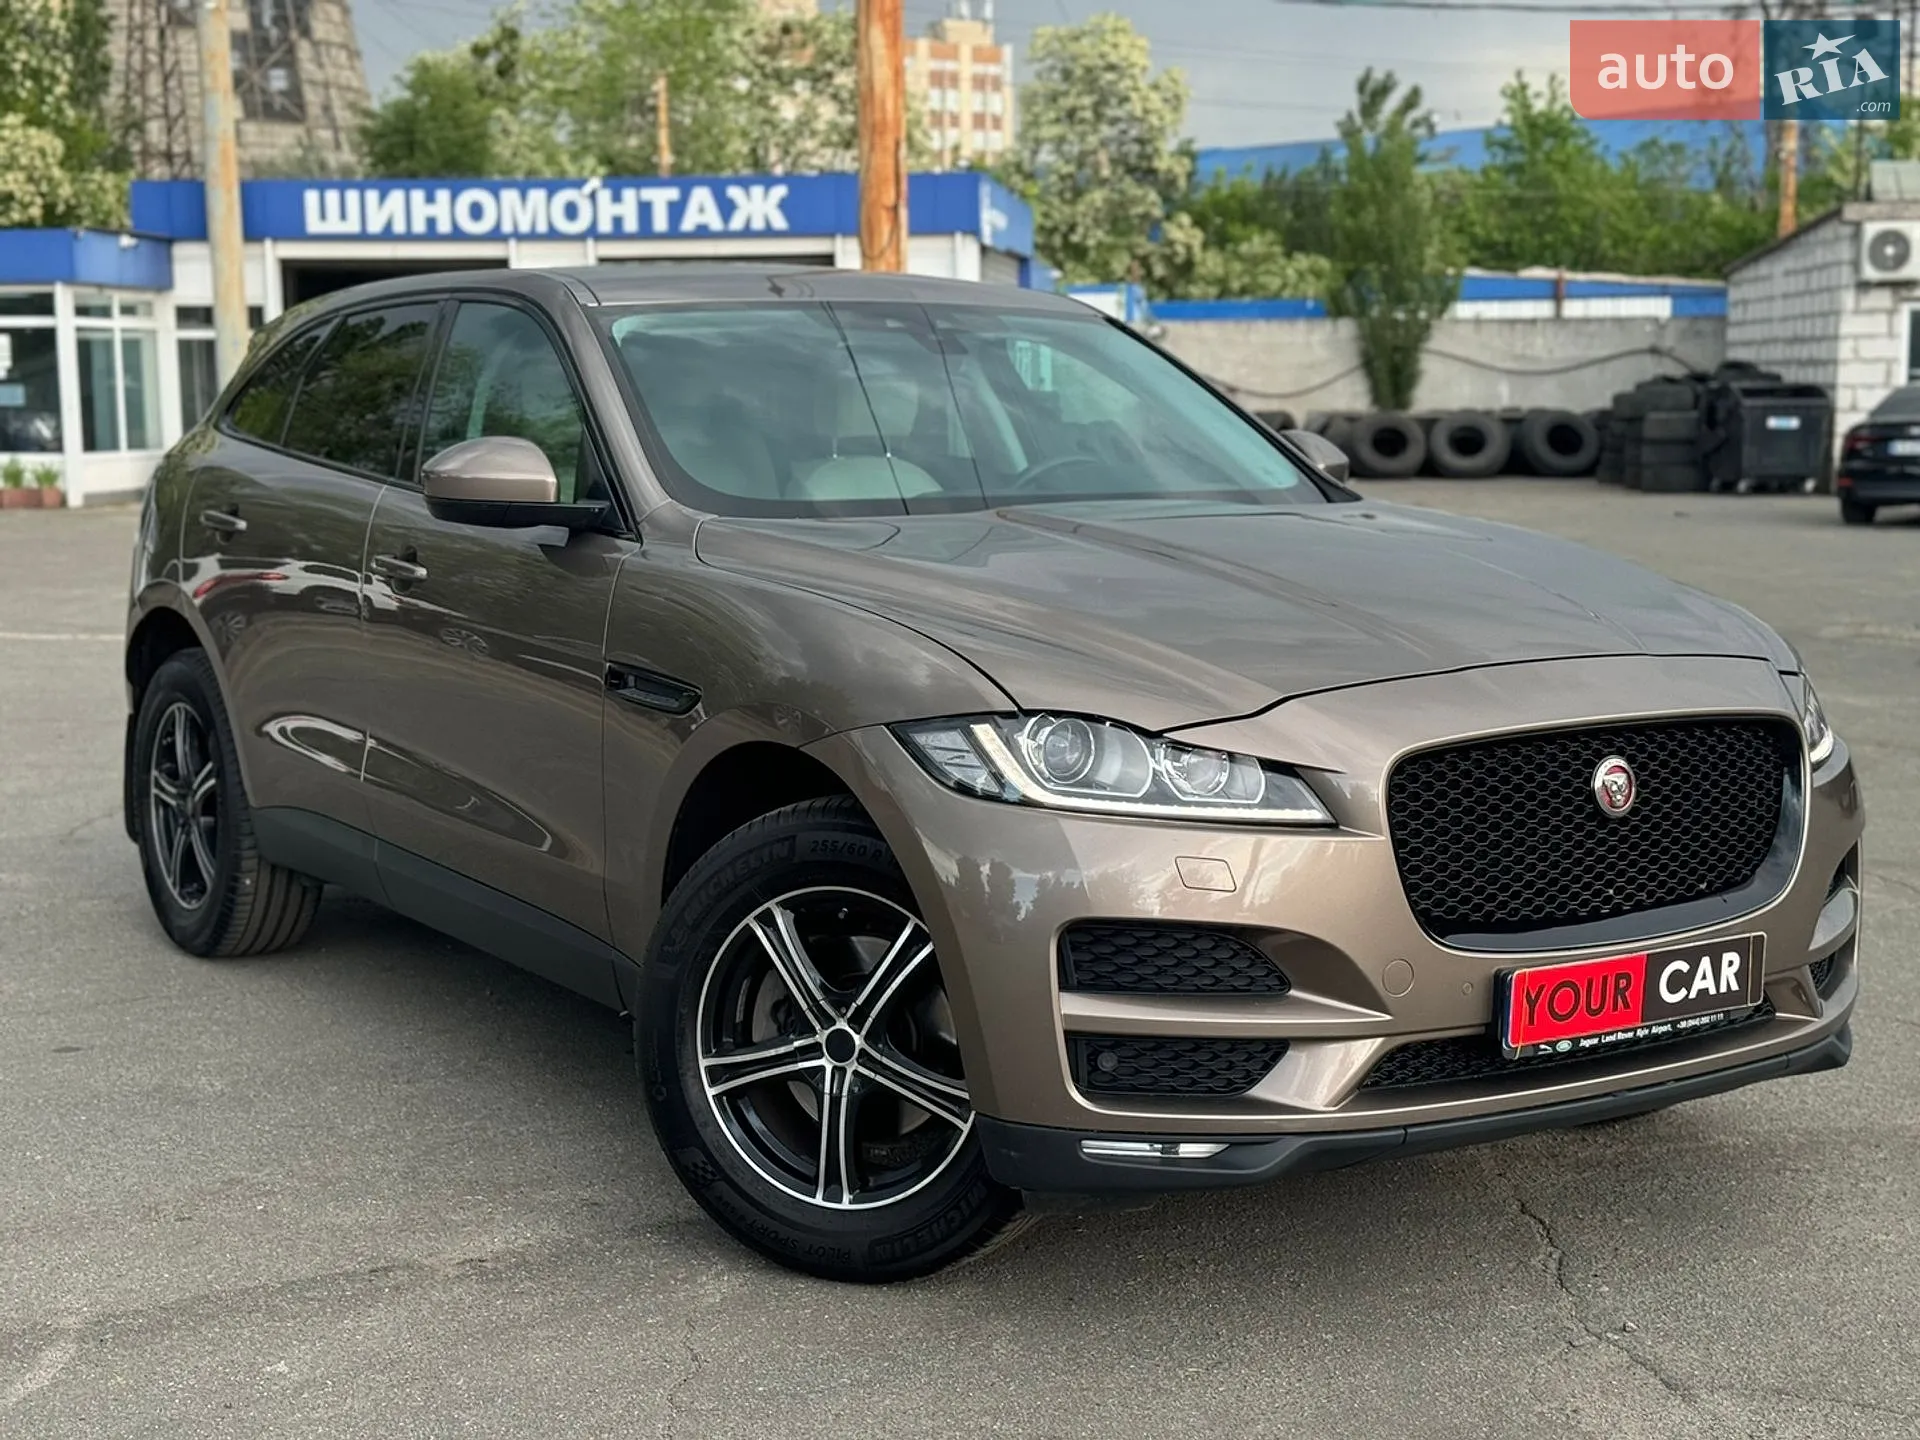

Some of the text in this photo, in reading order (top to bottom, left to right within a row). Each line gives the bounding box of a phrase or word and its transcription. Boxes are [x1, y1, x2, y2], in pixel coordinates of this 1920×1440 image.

[303, 185, 790, 235] ШИНОМОНТАЖ
[811, 839, 867, 858] 255/60
[683, 835, 797, 926] MICHELIN
[1526, 951, 1741, 1026] YOUR CAR
[1579, 1037, 1599, 1048] Jaguar
[1601, 1033, 1617, 1043] Land
[1617, 1031, 1634, 1041] Rover
[748, 1219, 800, 1251] SPORT
[805, 1243, 852, 1263] PILOT
